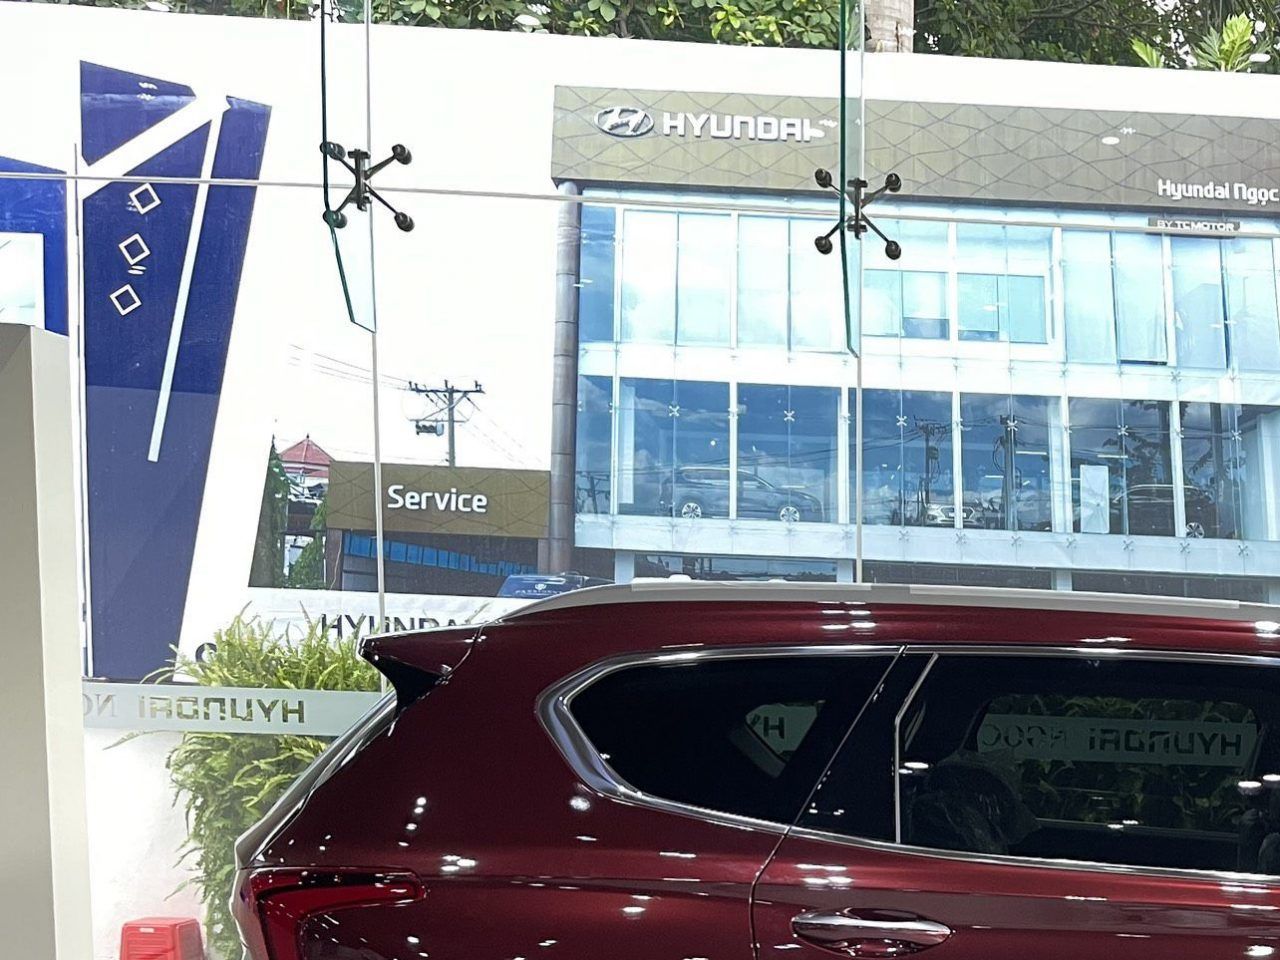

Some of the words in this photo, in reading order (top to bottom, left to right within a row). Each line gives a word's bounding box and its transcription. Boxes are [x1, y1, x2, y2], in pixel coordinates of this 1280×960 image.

[662, 111, 814, 143] HYUNDAI
[1157, 178, 1229, 201] Hyundai
[387, 485, 488, 513] Service
